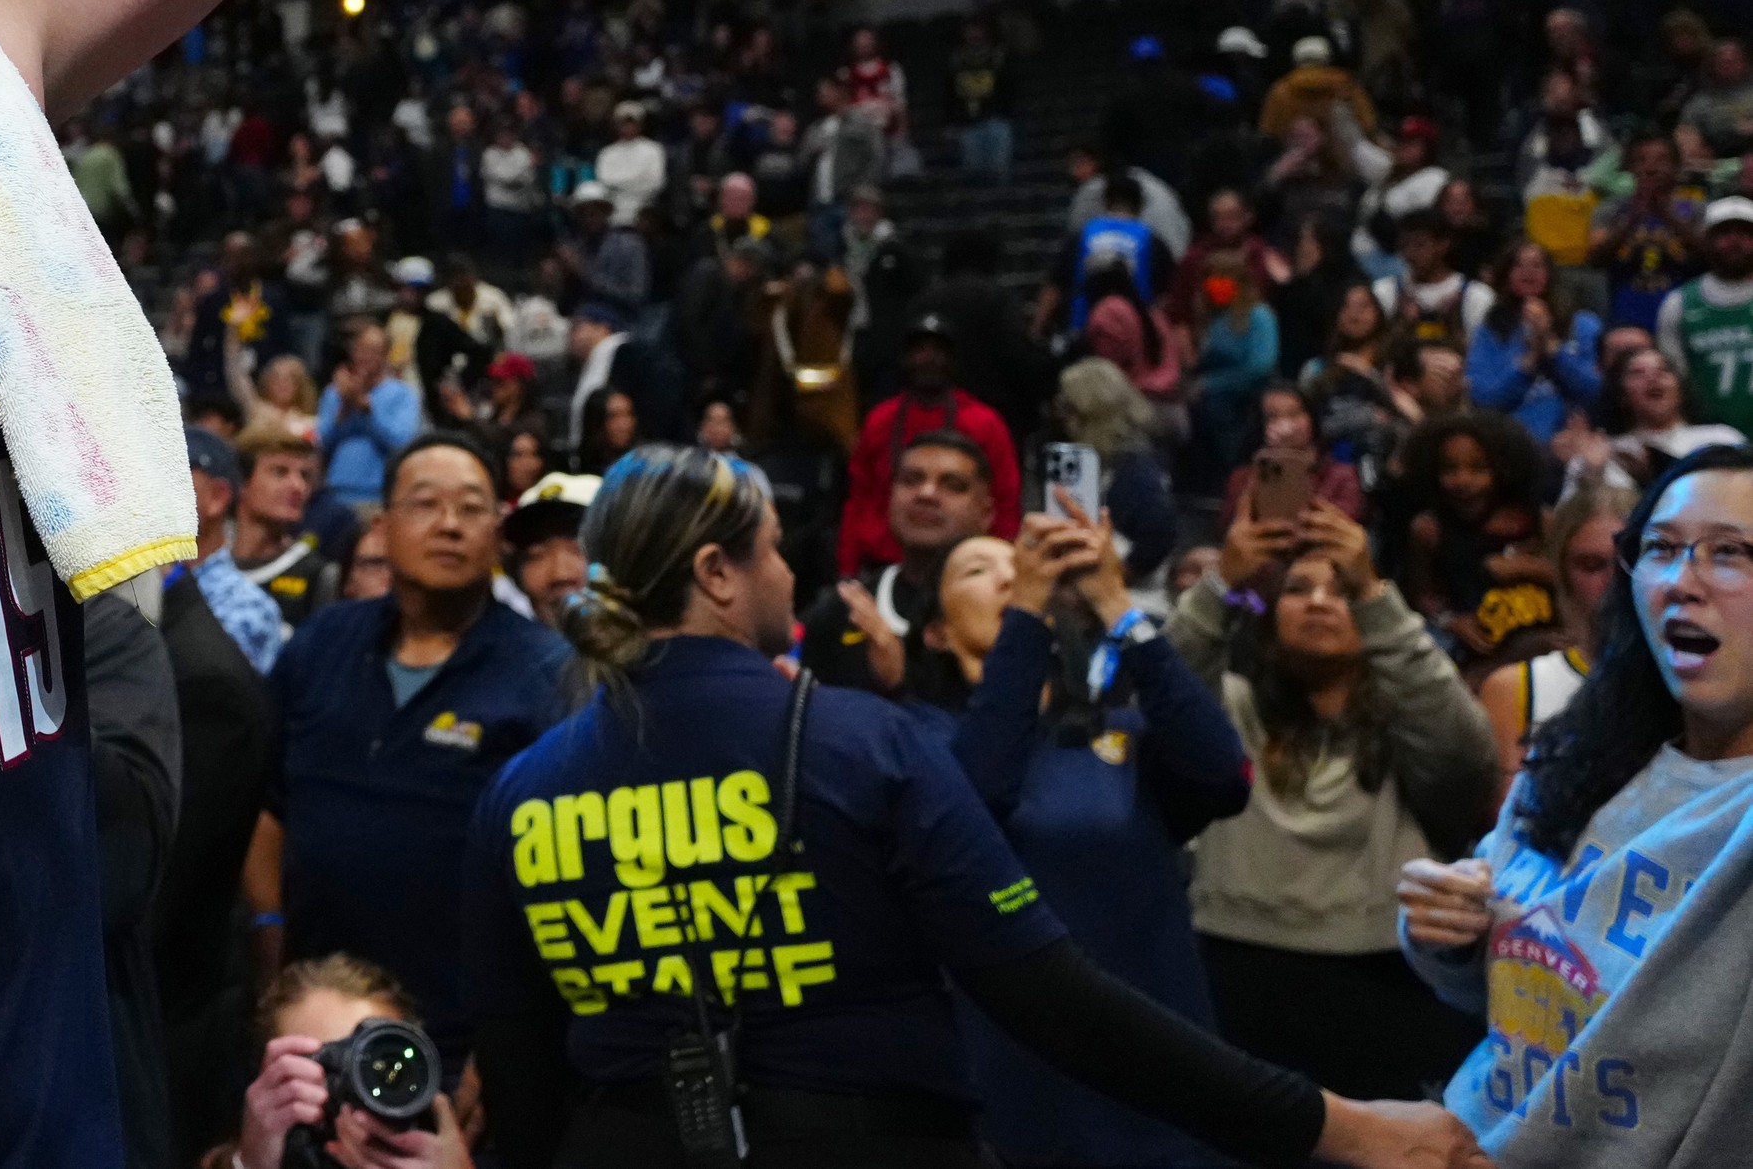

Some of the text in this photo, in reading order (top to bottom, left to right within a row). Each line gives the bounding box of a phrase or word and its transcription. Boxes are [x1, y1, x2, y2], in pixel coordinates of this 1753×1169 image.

[511, 770, 778, 888] argus
[524, 872, 817, 959] EVENT
[551, 941, 837, 1015] STAFF
[1496, 936, 1593, 992] DENVER
